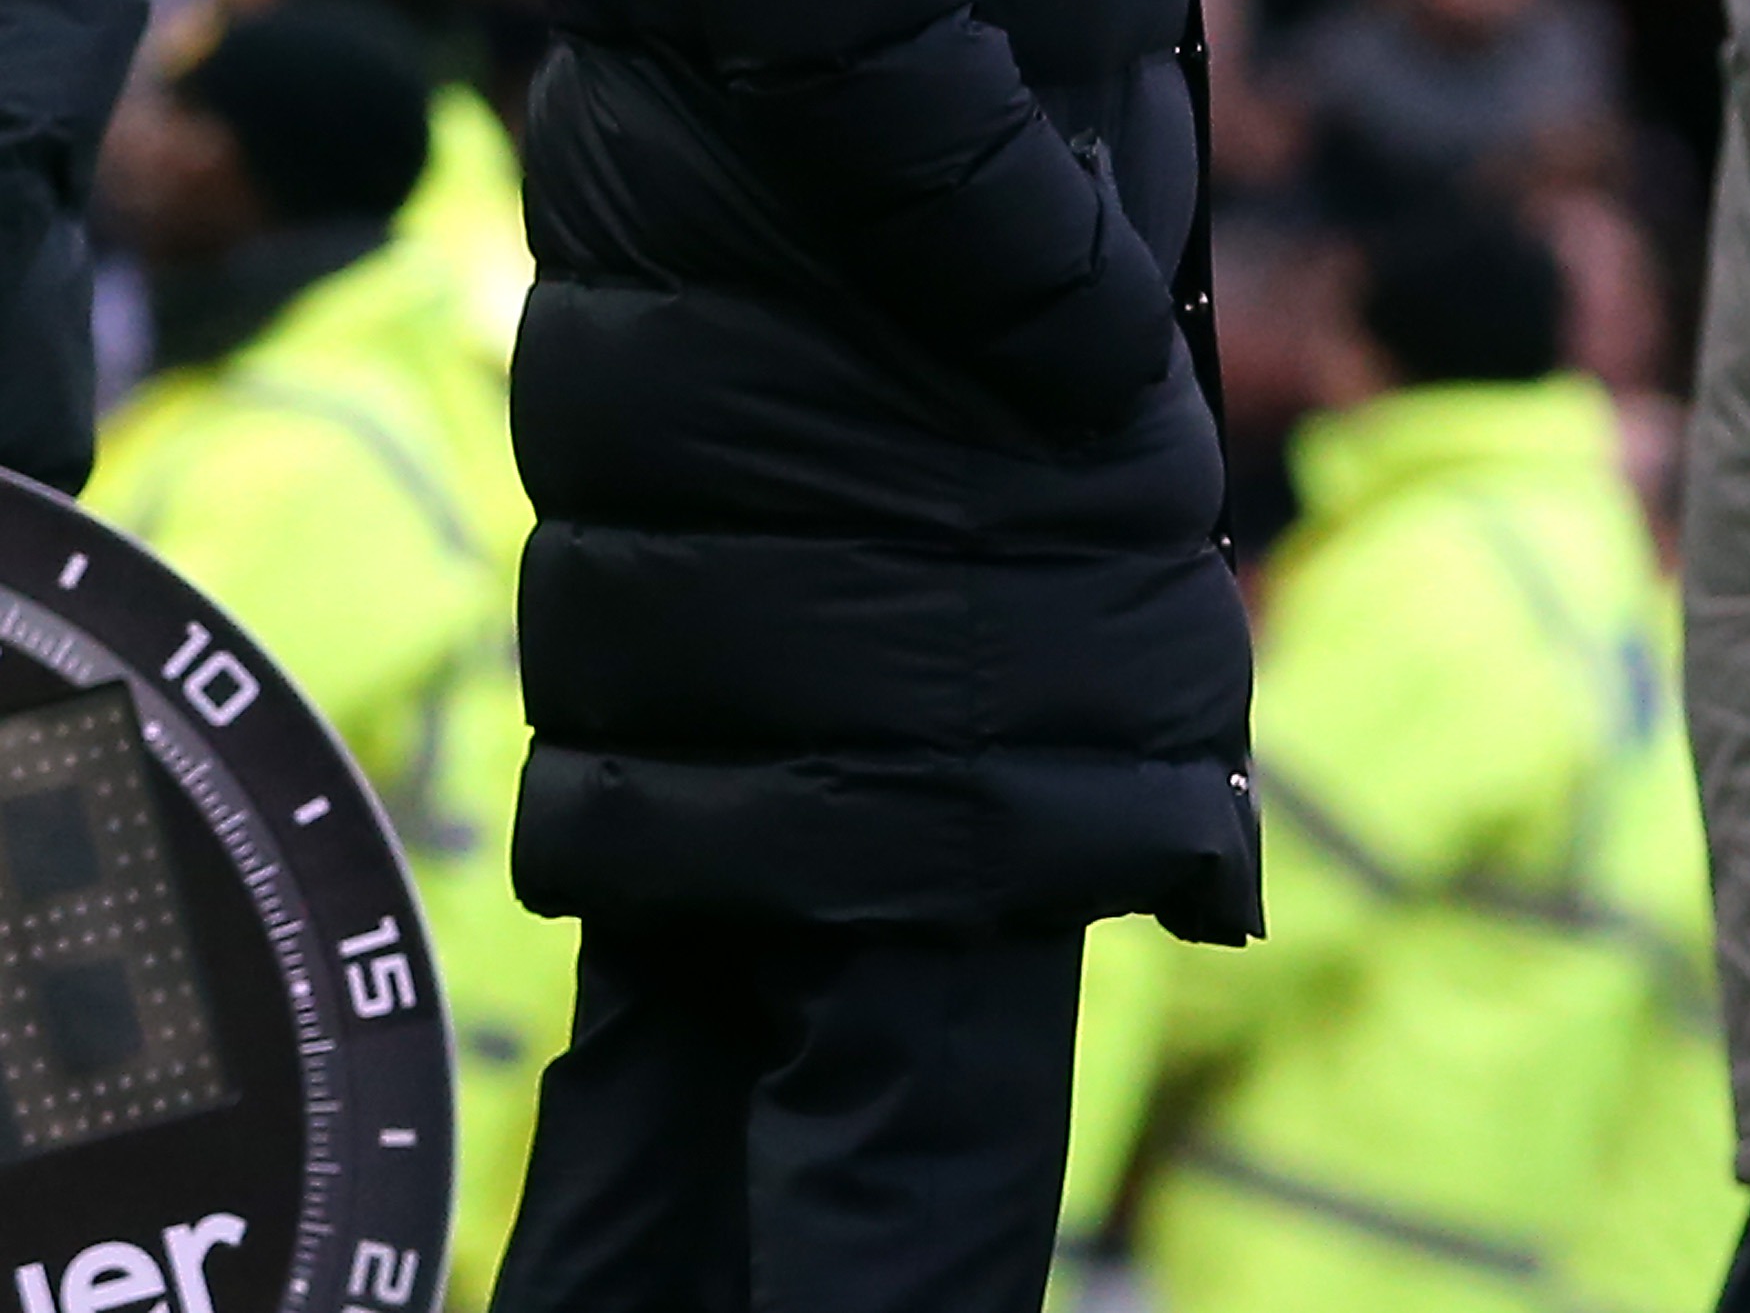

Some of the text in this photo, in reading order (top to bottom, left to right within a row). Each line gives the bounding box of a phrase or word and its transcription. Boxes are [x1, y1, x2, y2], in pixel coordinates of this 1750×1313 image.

[161, 619, 261, 727] 10
[337, 914, 418, 1020] 15
[345, 1238, 420, 1313] 2
